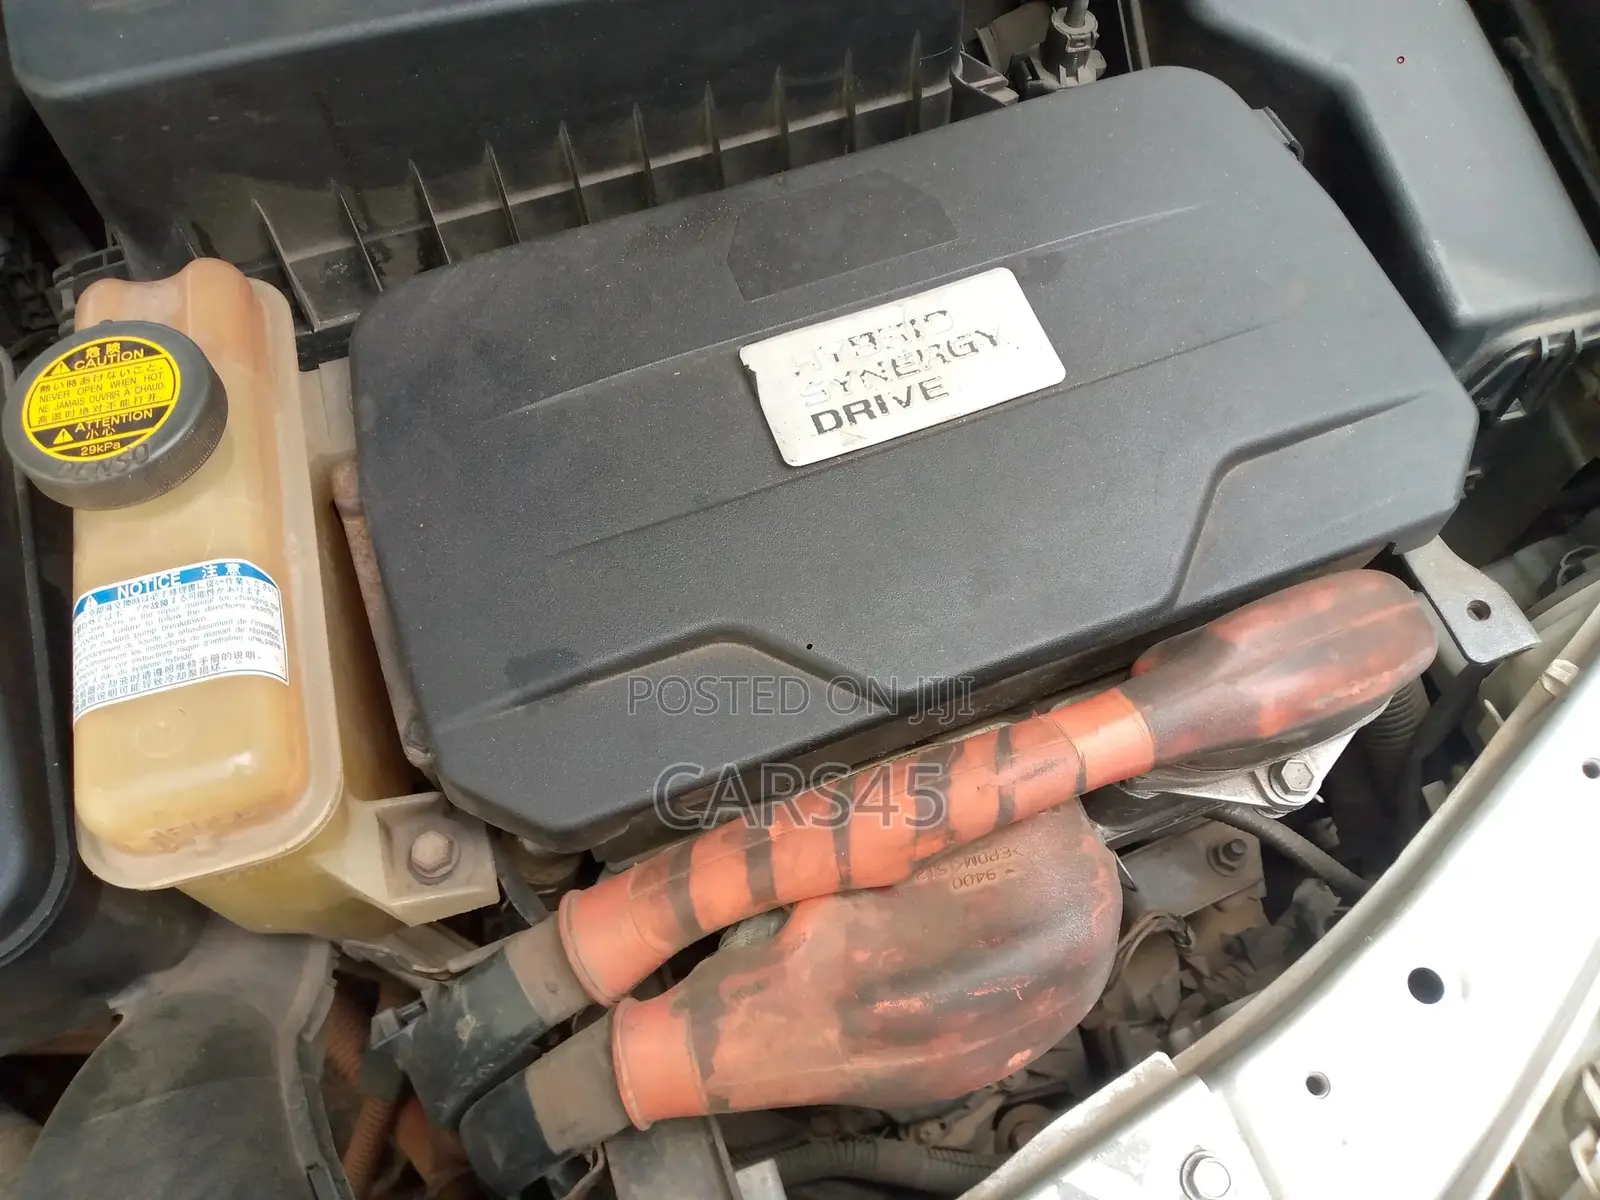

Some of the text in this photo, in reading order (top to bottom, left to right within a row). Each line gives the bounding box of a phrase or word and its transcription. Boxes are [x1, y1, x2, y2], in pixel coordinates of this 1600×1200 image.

[74, 348, 144, 371] CAUTION
[801, 322, 1001, 406] SYNERGY
[39, 371, 163, 403] NEVER OPEN WHEN HOT
[38, 404, 49, 414] NE
[53, 398, 85, 411] JAMAIS
[89, 390, 120, 404] OUVRIR
[810, 375, 950, 436] DRIVE
[76, 408, 153, 433] ATTENTION
[86, 425, 116, 440] 小心
[80, 441, 121, 456] 29kPa
[117, 572, 181, 600] NOTICE
[951, 869, 998, 891] 9400
